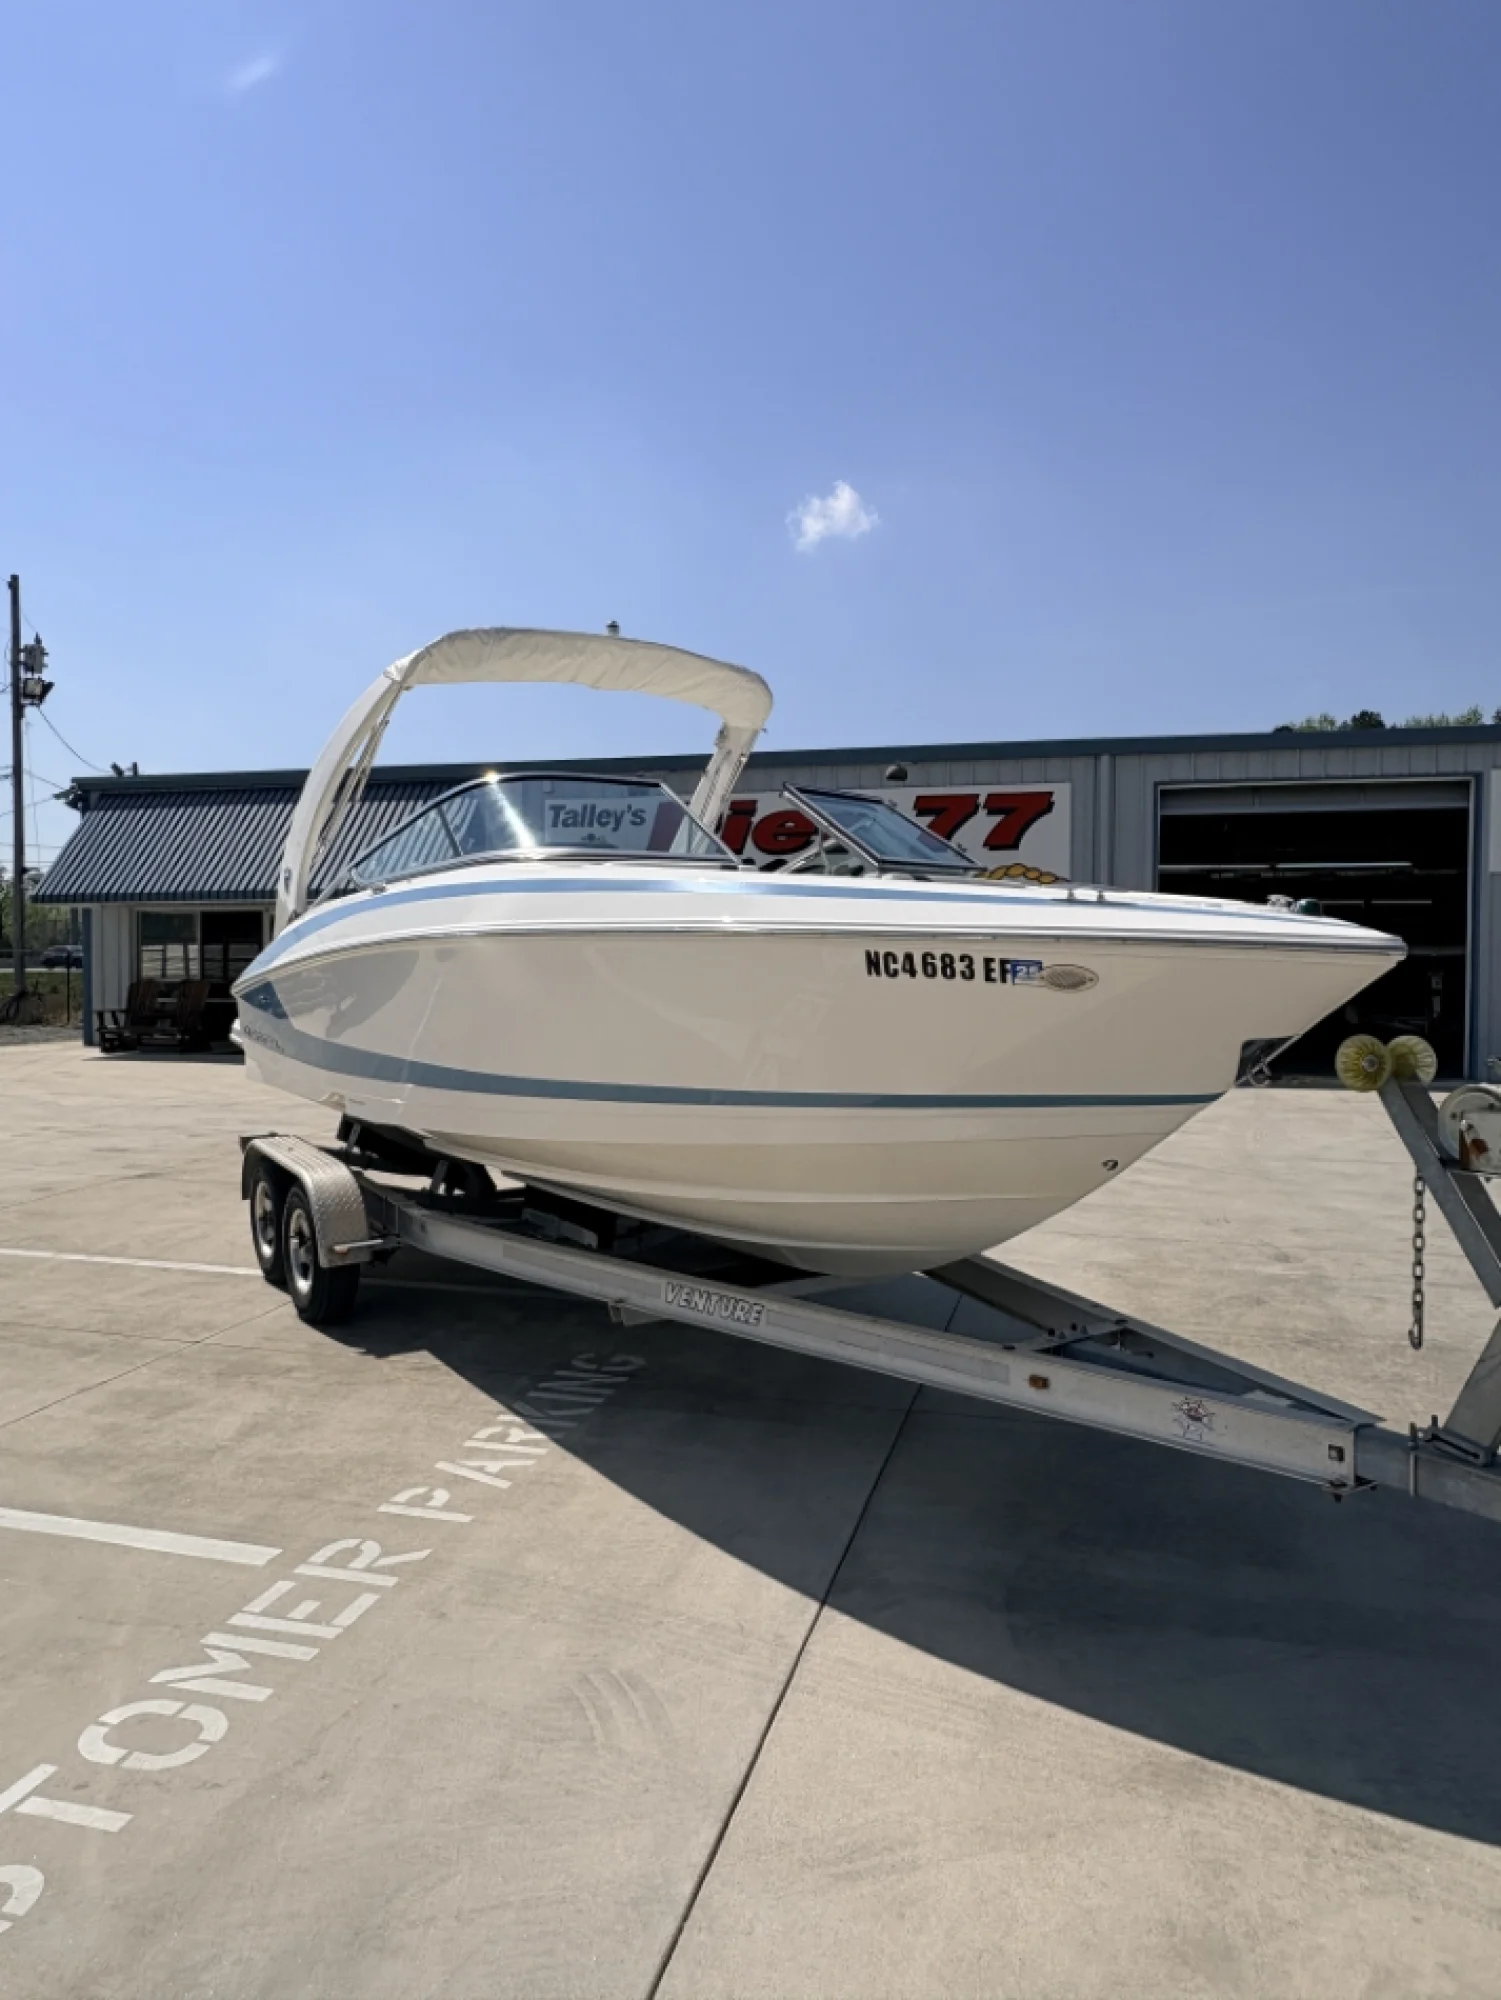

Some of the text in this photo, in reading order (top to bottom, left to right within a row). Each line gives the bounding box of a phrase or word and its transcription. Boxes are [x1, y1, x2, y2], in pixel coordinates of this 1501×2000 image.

[548, 803, 647, 832] Talley's
[914, 791, 1055, 851] 77
[665, 1280, 764, 1326] VENTURE
[377, 1353, 646, 1522] PARKING
